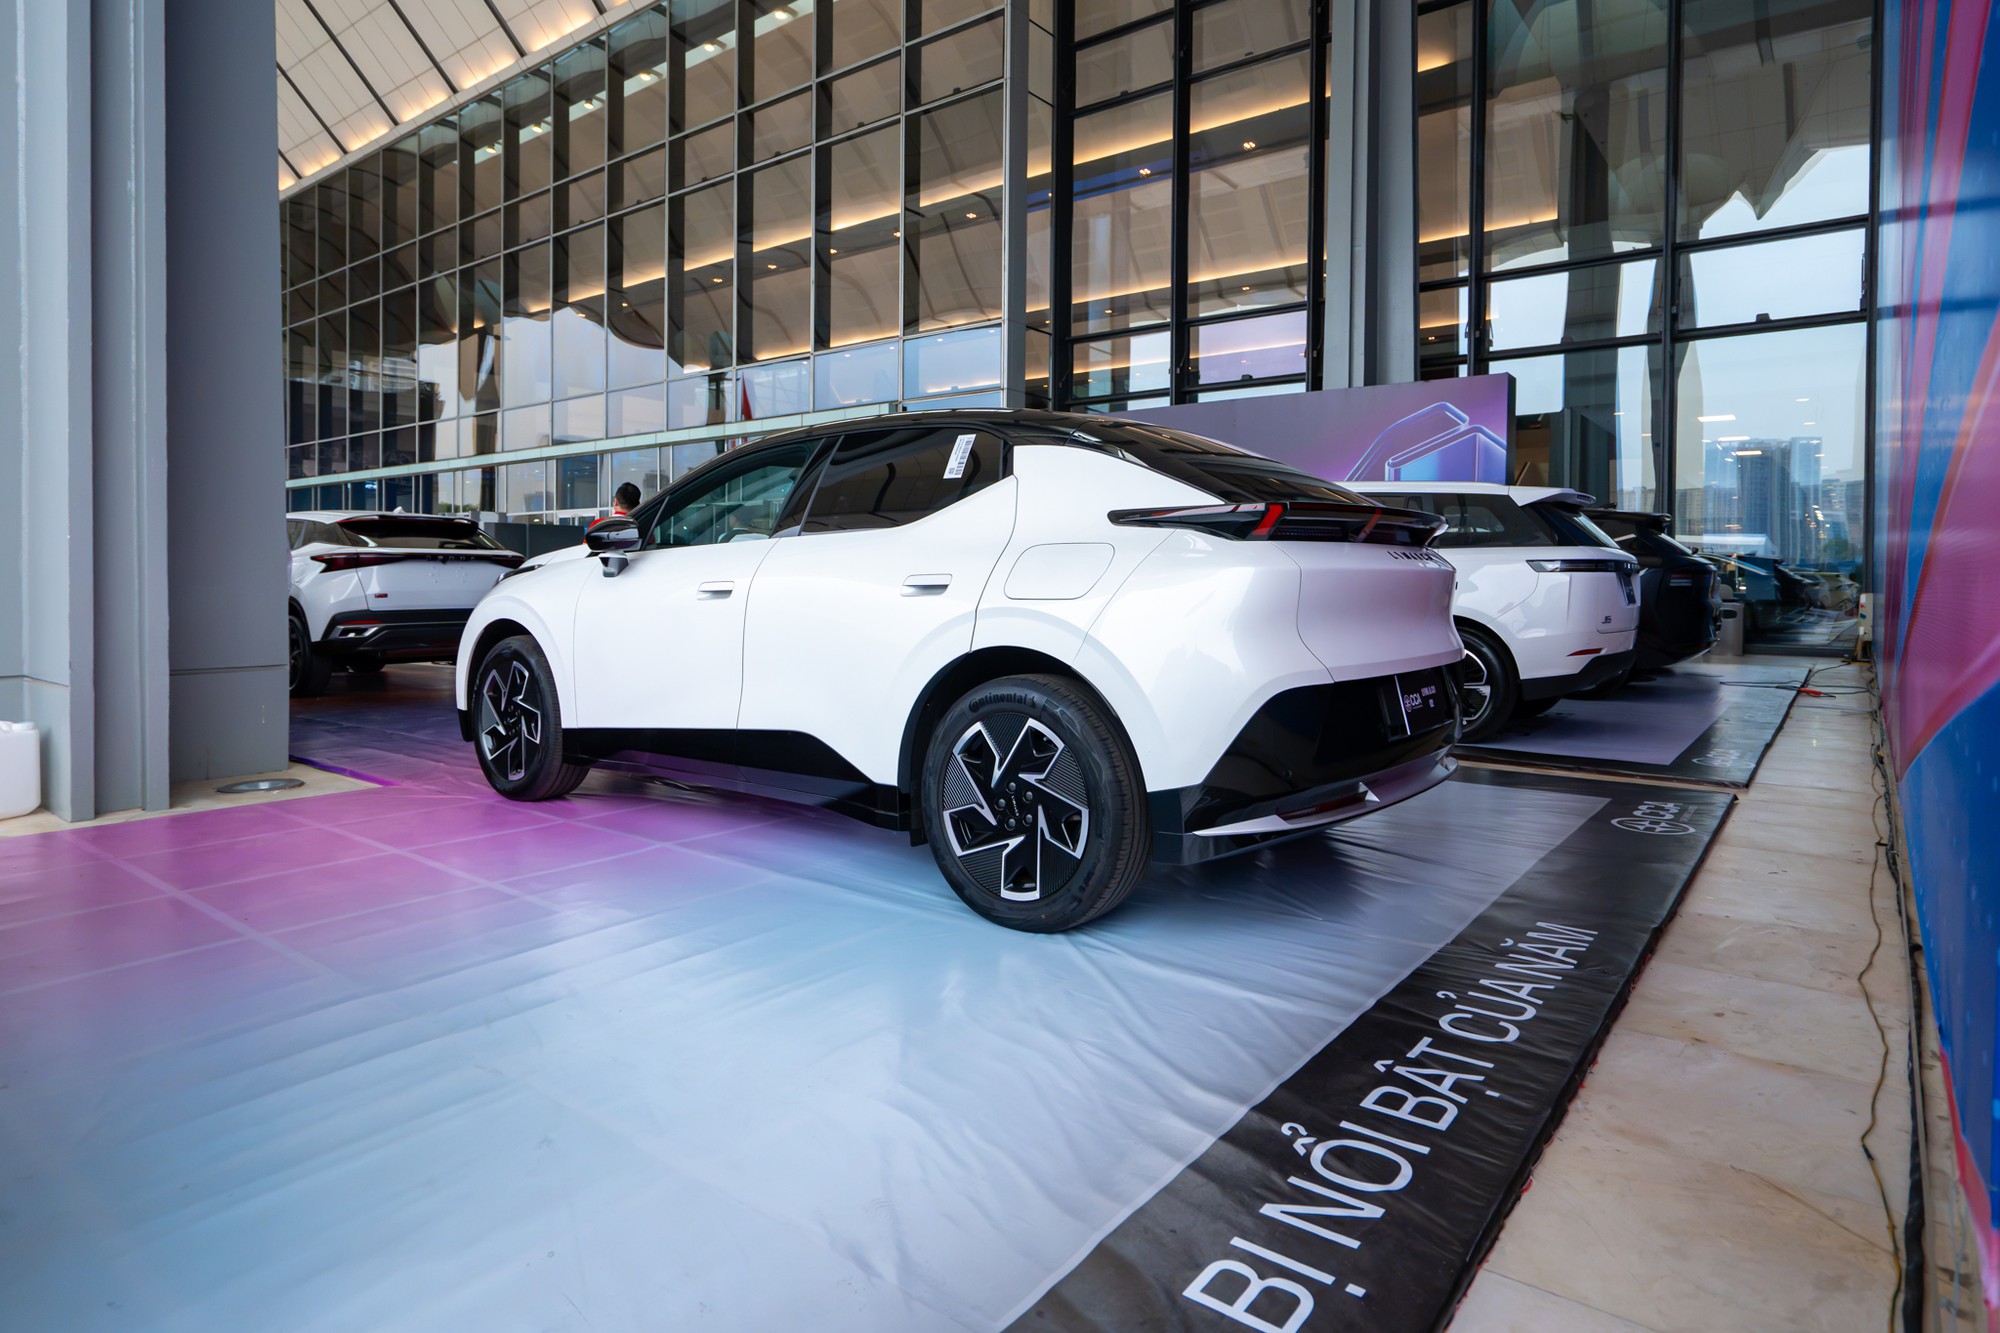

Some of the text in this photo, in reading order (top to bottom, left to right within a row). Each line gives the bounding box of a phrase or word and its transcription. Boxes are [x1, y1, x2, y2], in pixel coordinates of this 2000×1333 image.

[968, 692, 1028, 713] Continental
[1181, 921, 1598, 1333] BỊ NỔI BẬT CỦA NĂM
